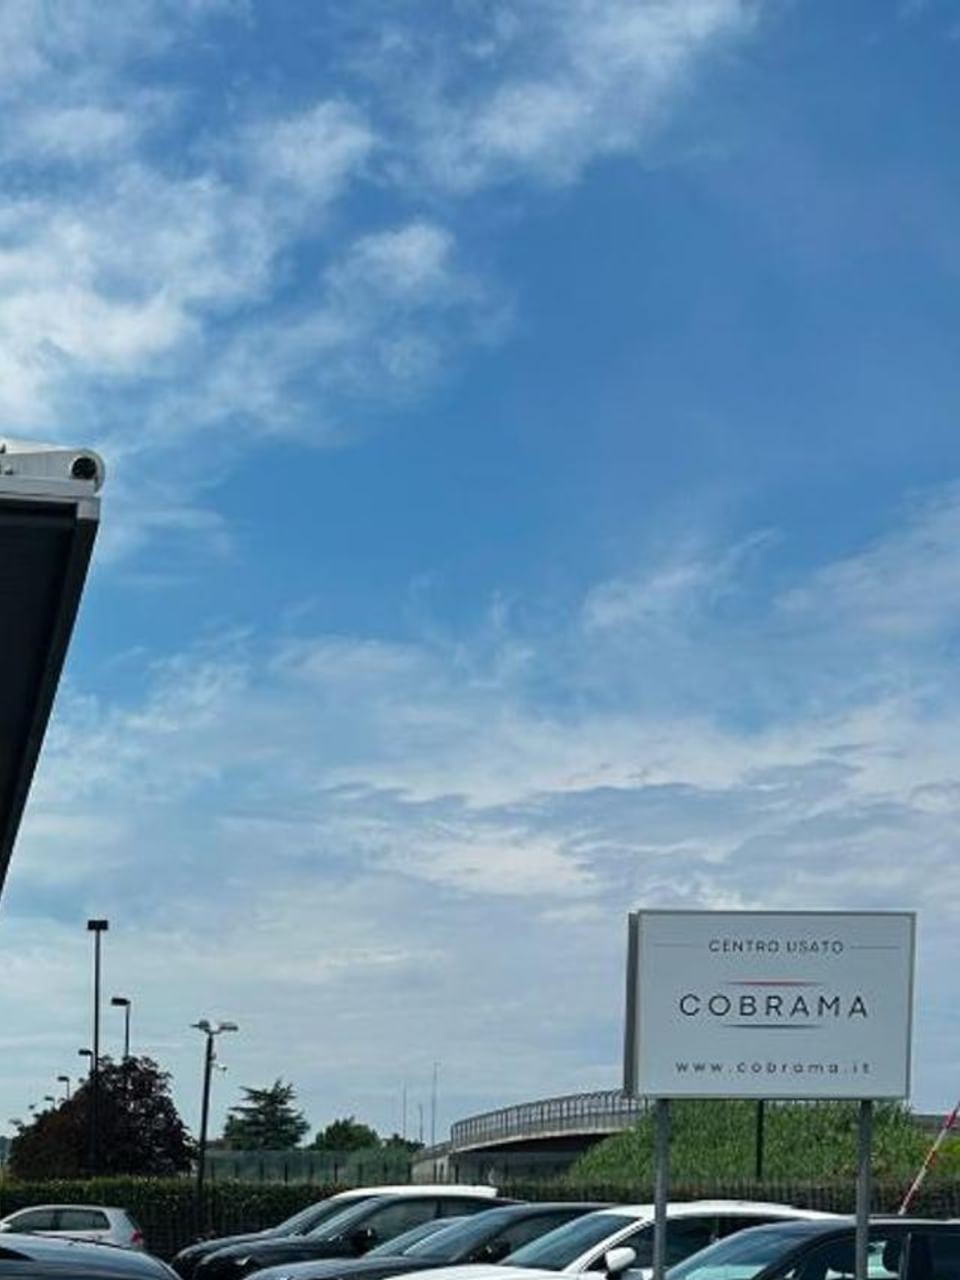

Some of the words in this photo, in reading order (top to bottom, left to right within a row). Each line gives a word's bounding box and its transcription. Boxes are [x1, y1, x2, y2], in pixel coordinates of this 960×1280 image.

[708, 939, 780, 953] CENTRO
[786, 940, 845, 954] USATO
[678, 993, 869, 1018] COBRAMA
[675, 1061, 872, 1075] www.cobrama.it
